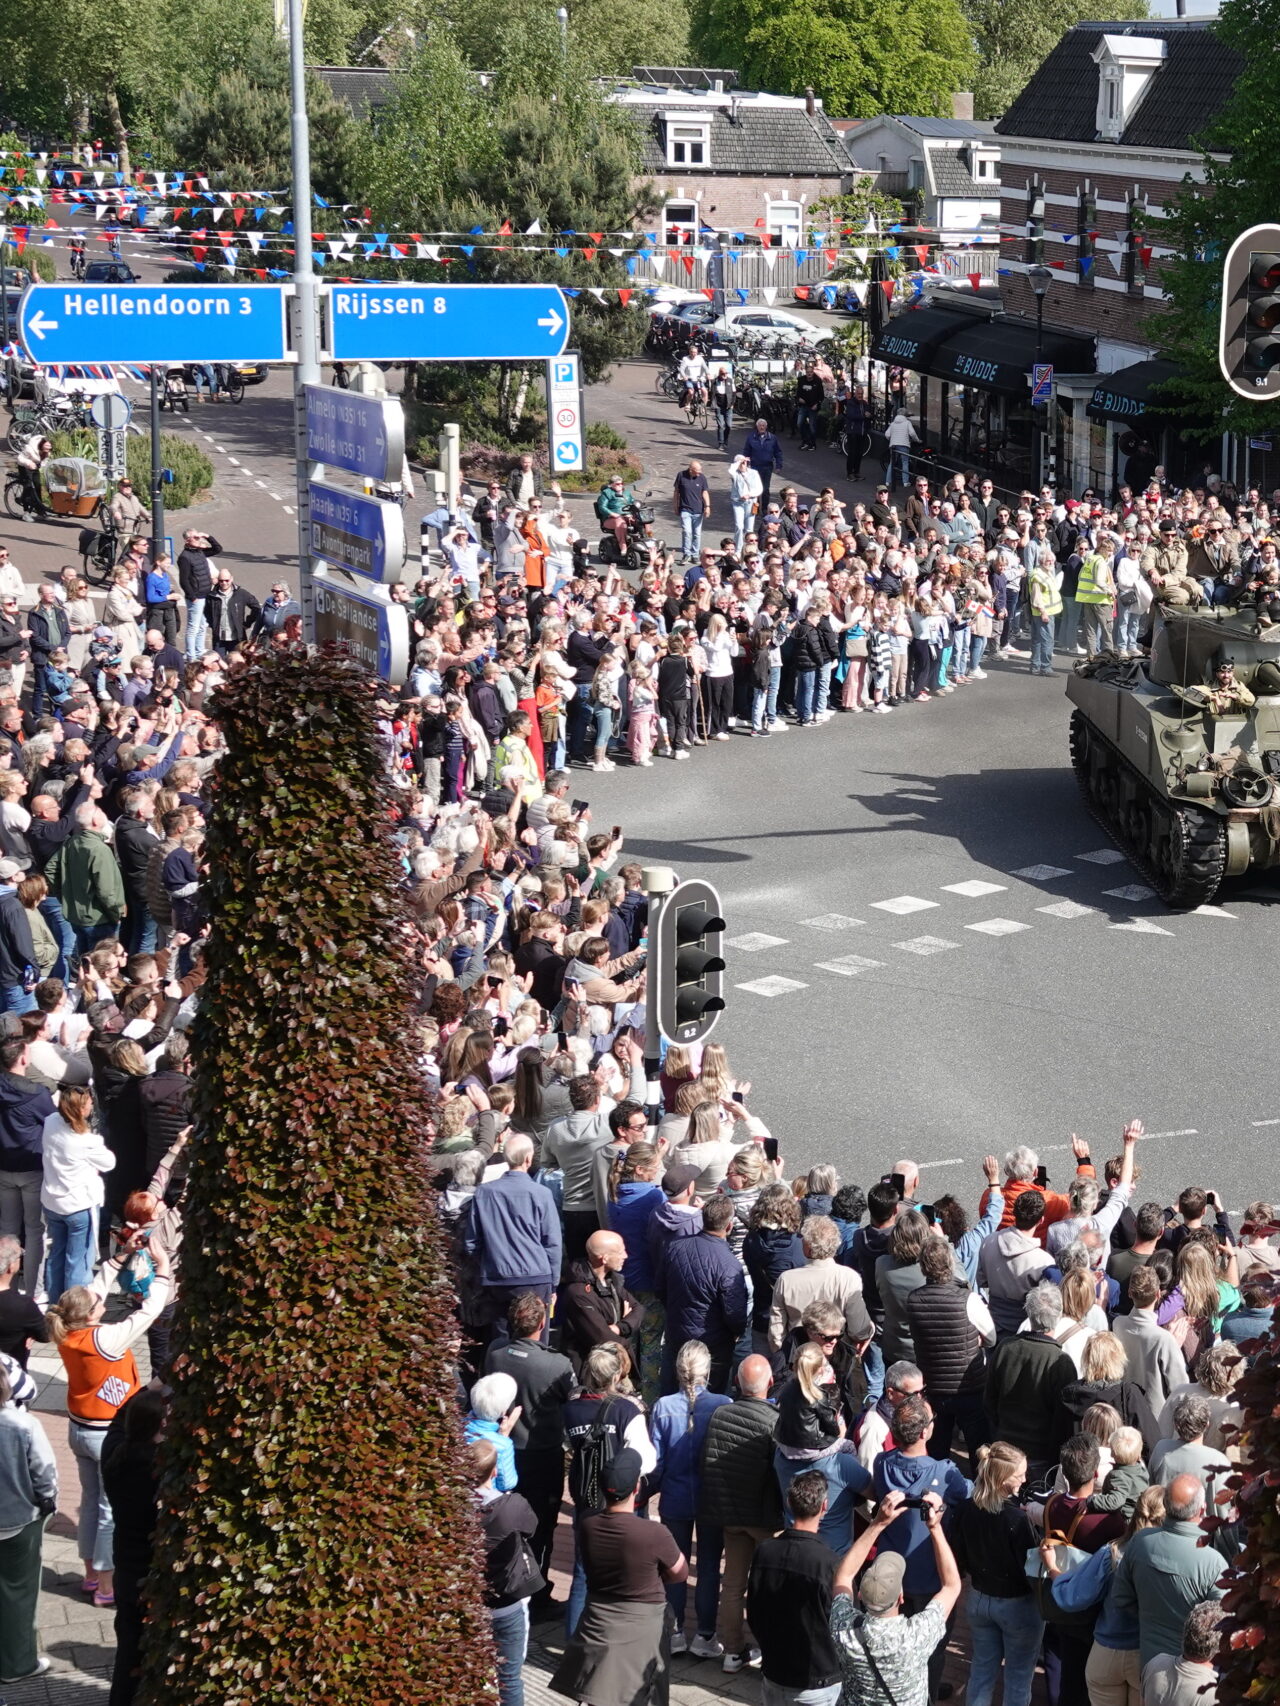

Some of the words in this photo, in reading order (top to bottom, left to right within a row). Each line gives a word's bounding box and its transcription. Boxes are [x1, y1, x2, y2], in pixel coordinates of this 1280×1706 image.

[64, 293, 231, 316] Hellendoorn
[239, 297, 252, 315] 3
[336, 293, 425, 320] Rijssen
[433, 296, 447, 315] 8
[887, 337, 919, 358] BUDDE
[963, 358, 998, 382] BUDDE
[1255, 377, 1268, 386] 9.1
[308, 394, 336, 419] Almelo
[357, 410, 367, 427] 16
[560, 414, 573, 423] 30
[308, 428, 336, 454] Zwolle
[356, 445, 366, 462] 31
[310, 491, 334, 517] Haarle
[353, 510, 359, 526] 6
[321, 531, 372, 565] Avonturenpark
[325, 593, 335, 614] De
[337, 599, 377, 632] Sallandse
